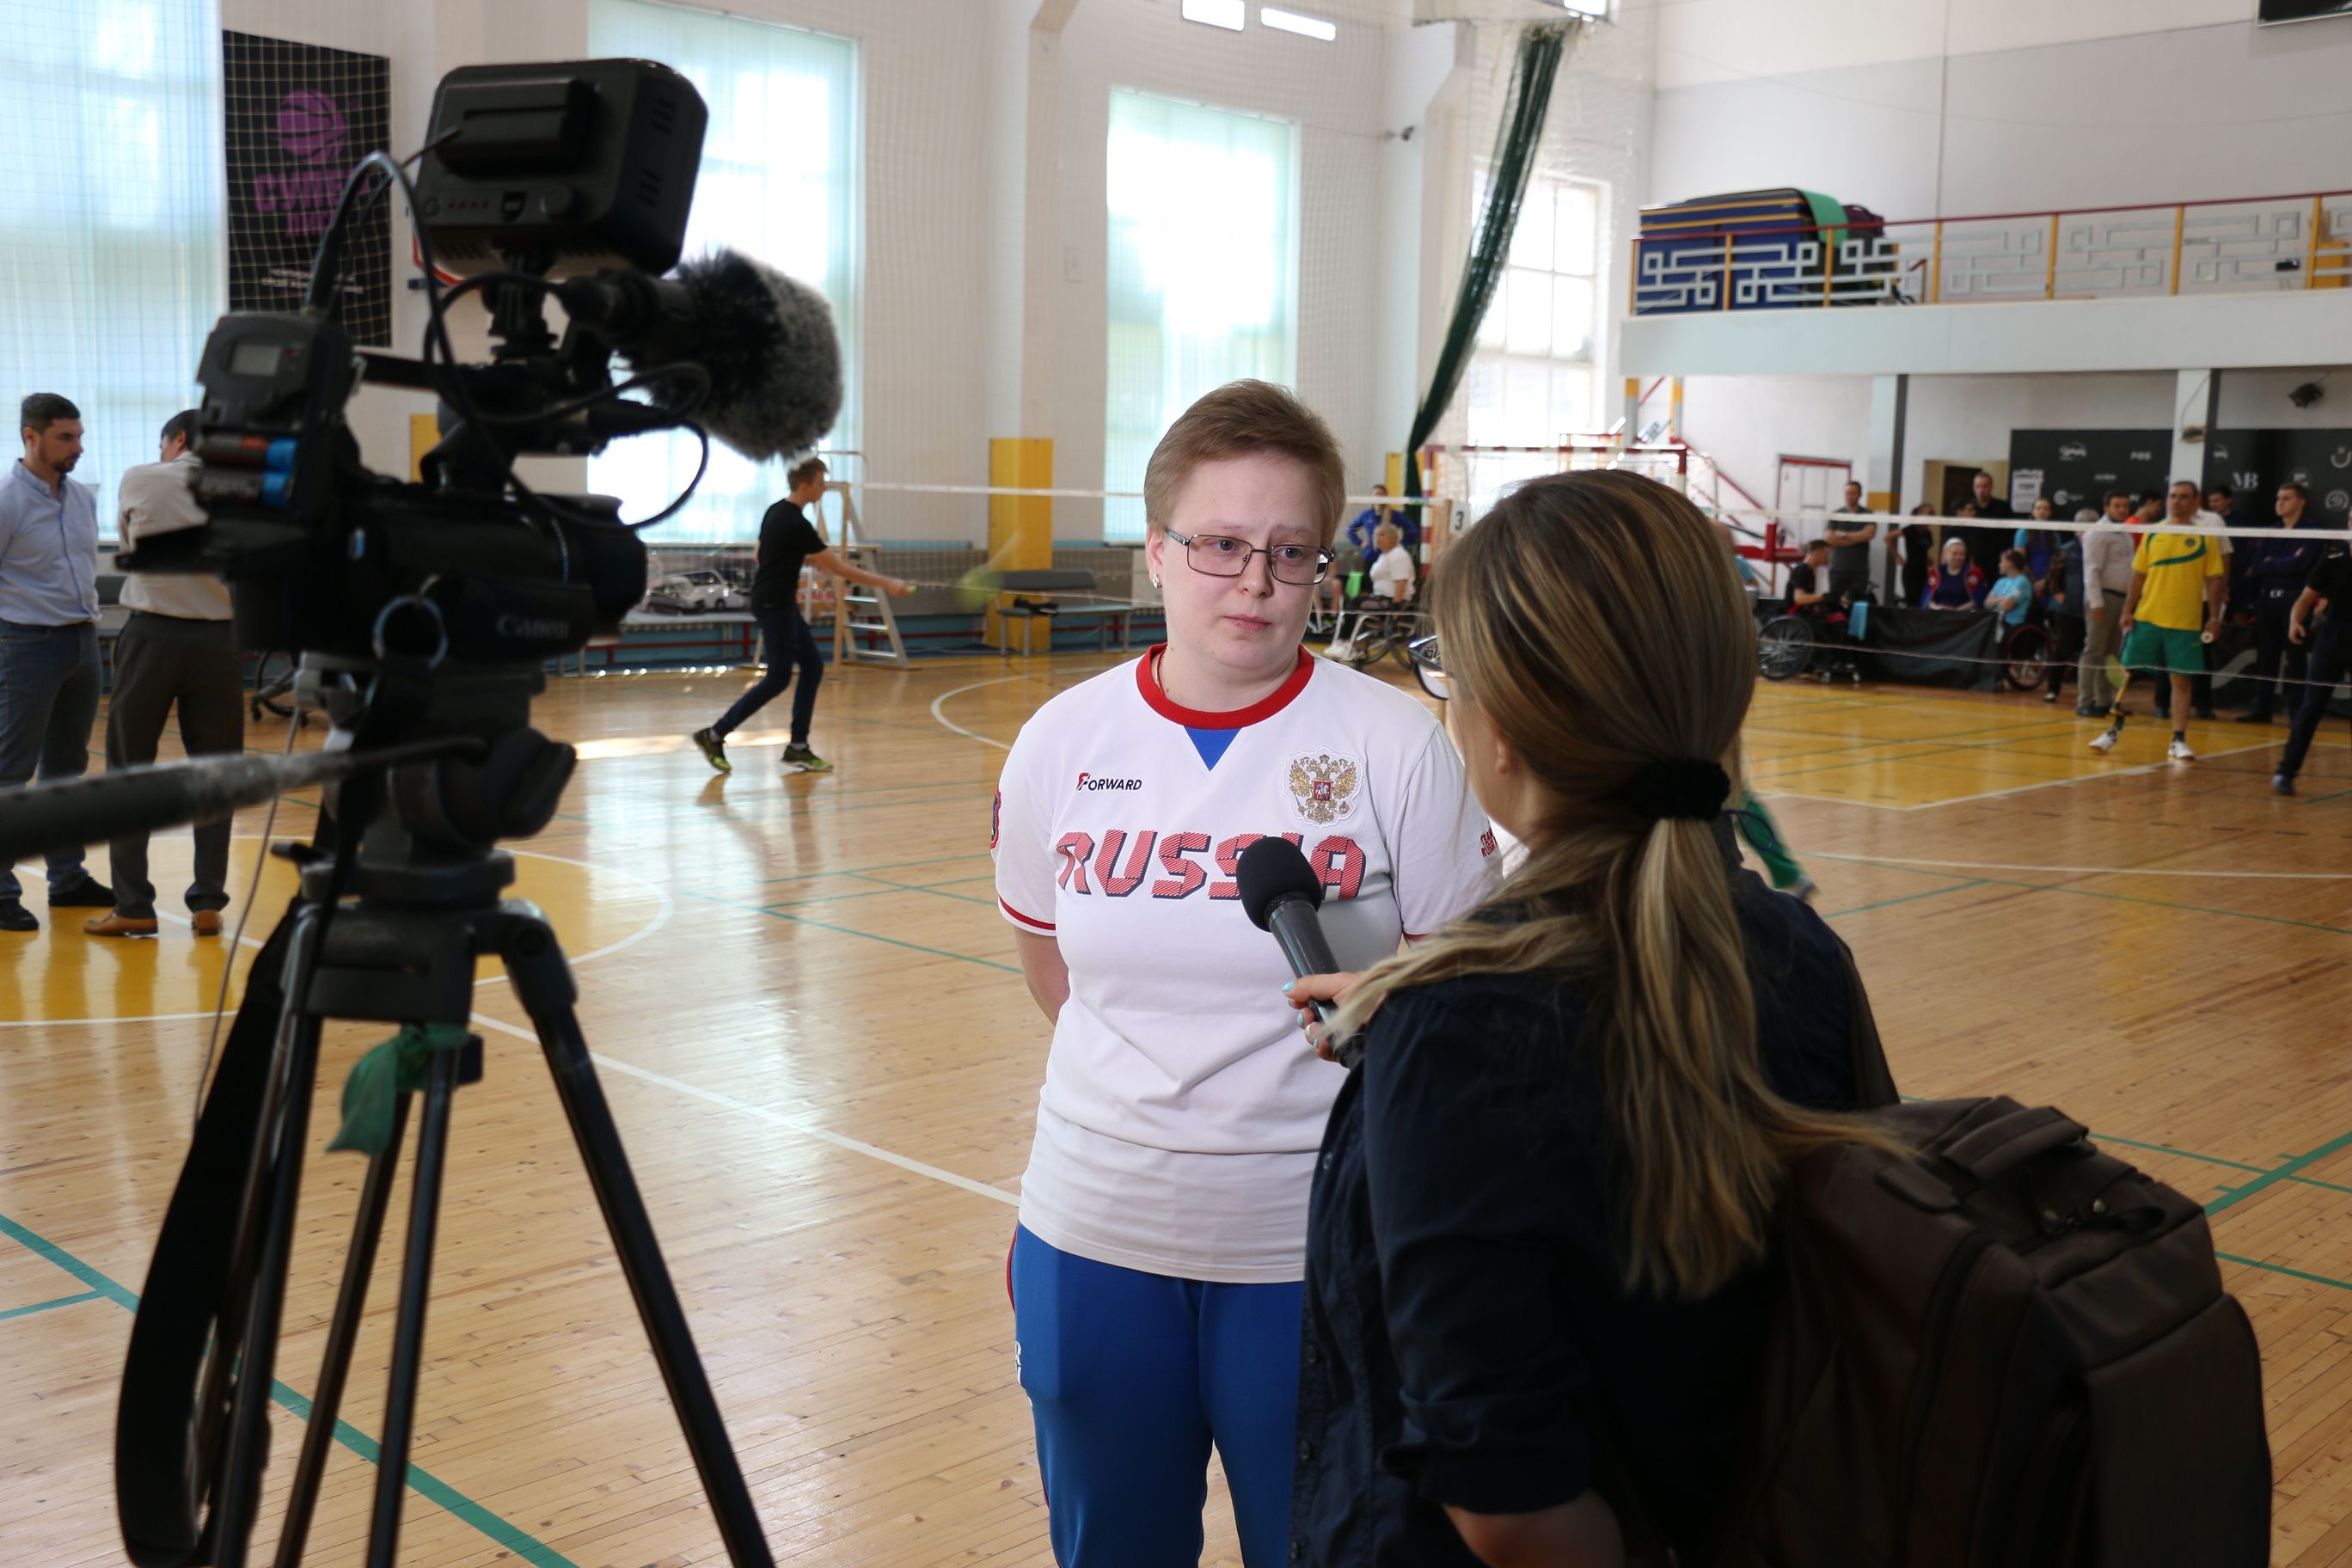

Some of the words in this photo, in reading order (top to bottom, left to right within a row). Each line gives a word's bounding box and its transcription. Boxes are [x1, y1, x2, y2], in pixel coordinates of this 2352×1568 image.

[1455, 510, 1464, 530] 3
[496, 614, 571, 640] Canon
[1076, 772, 1142, 791] FORWARD
[1055, 829, 1366, 901] RUSSA
